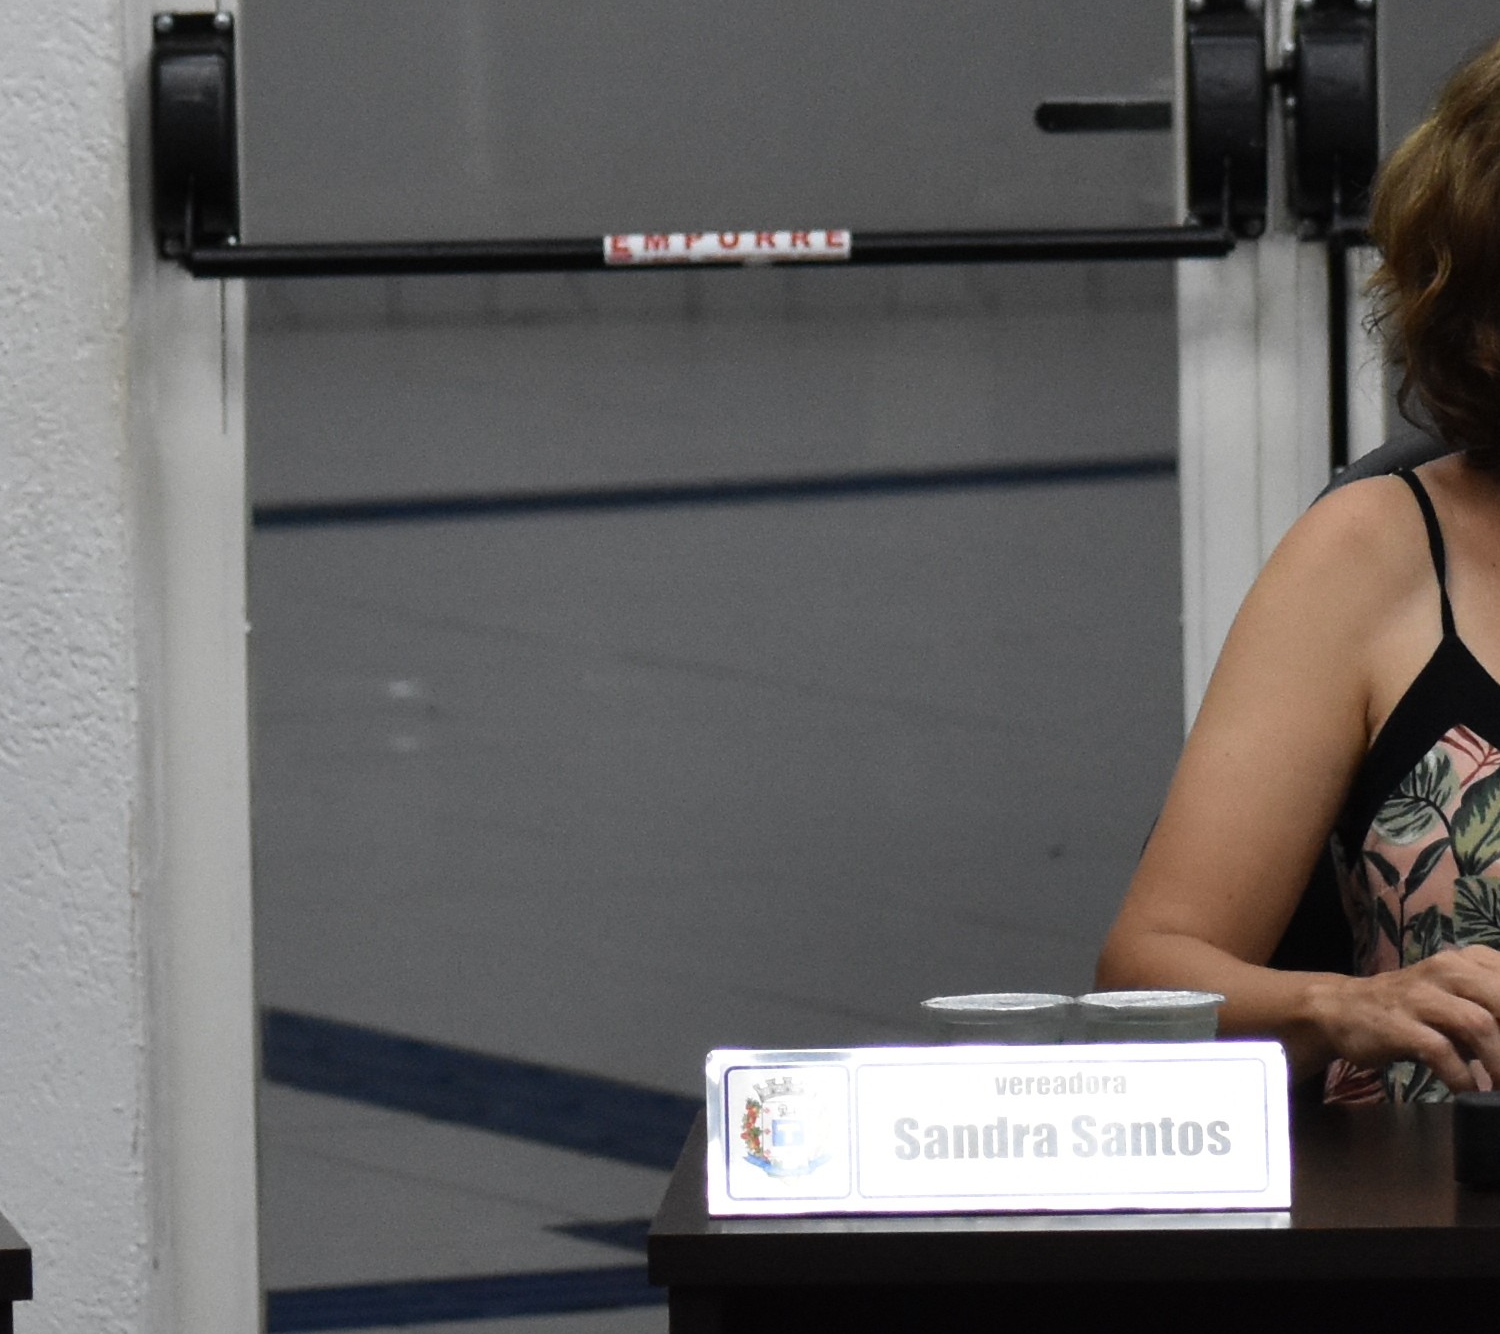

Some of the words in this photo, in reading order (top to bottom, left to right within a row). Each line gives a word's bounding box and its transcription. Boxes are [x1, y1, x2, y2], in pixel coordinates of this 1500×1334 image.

[994, 1072, 1128, 1097] vereadora
[893, 1116, 1059, 1160] Sandra
[1071, 1114, 1232, 1157] Santos
